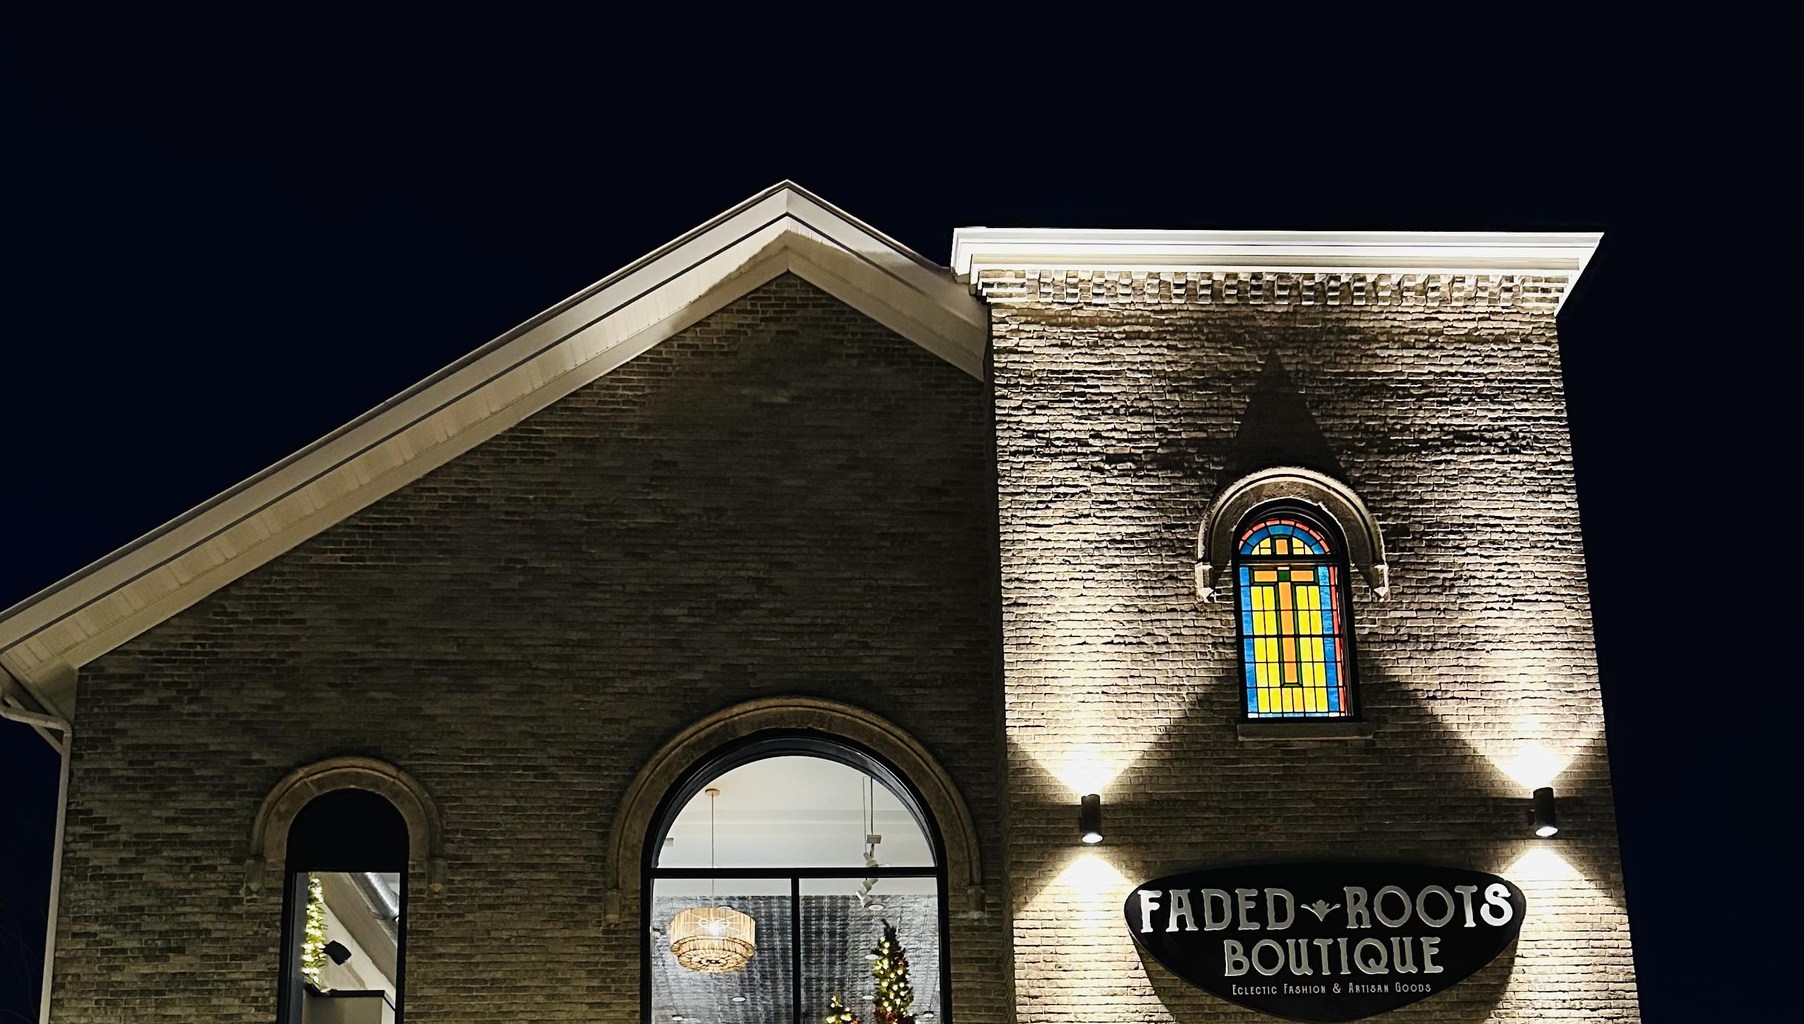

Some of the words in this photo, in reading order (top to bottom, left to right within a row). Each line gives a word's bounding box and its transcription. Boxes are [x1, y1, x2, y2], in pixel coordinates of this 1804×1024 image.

[1138, 888, 1295, 933] FADED
[1343, 883, 1514, 929] ROOTS
[1223, 936, 1445, 977] BOUTIQUE
[1232, 984, 1278, 996] ECLECTIC
[1283, 983, 1326, 995] FASHION
[1332, 982, 1342, 994] &
[1348, 982, 1389, 994] ARTISAN
[1395, 981, 1432, 993] GOODS
